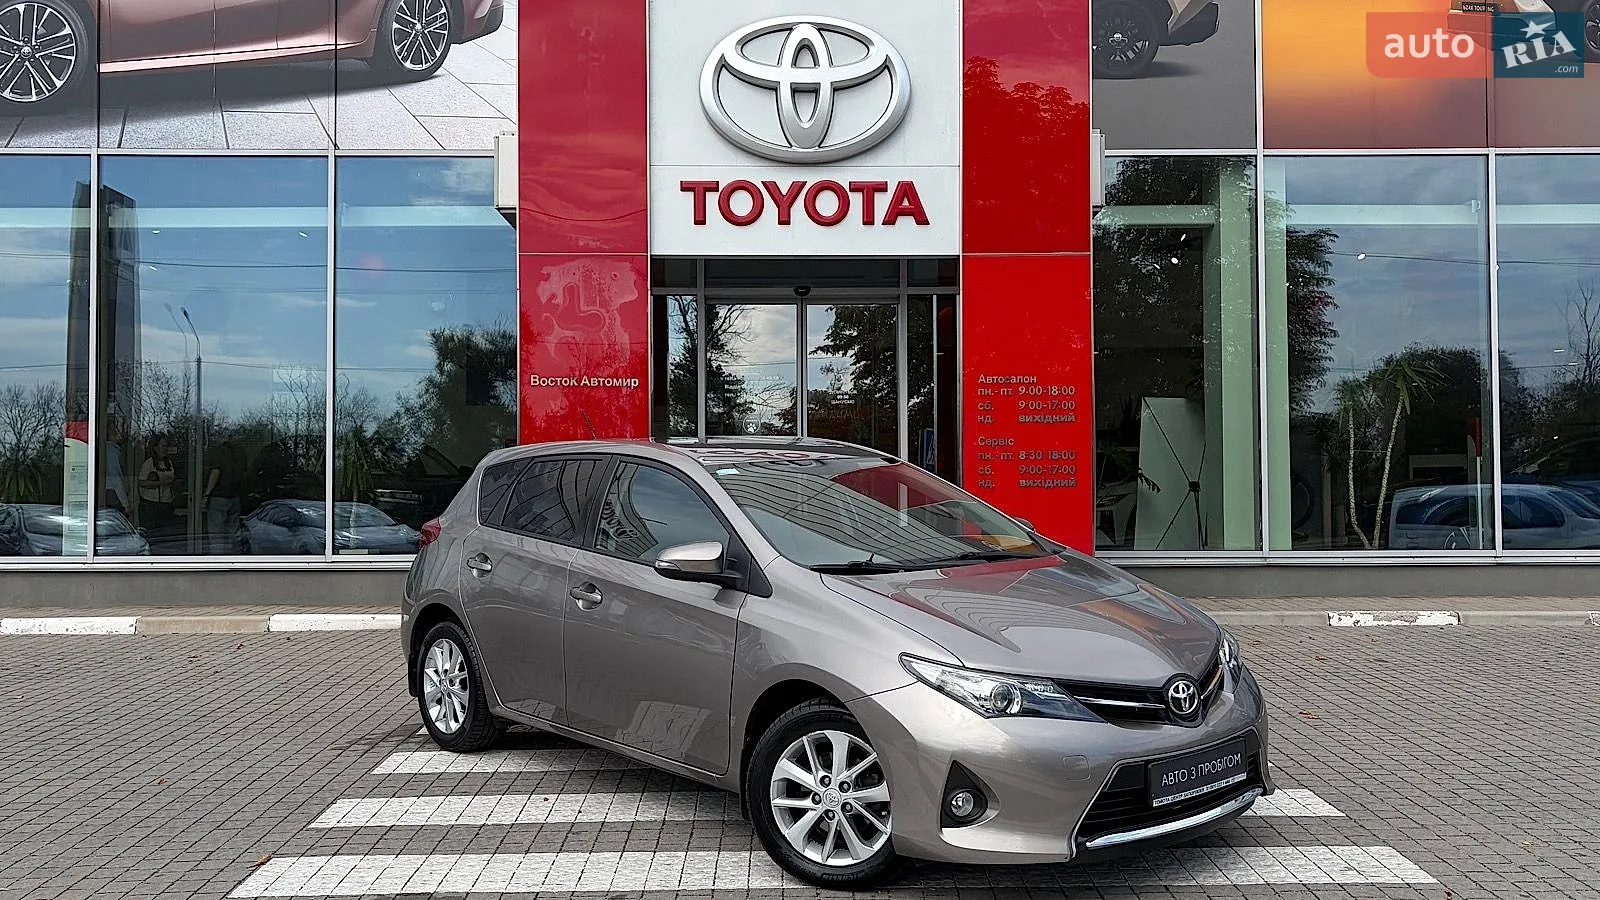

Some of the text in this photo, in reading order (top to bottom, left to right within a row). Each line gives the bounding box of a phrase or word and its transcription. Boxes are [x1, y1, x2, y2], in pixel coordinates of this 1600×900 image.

[680, 179, 931, 226] TOYOTA
[530, 374, 639, 389] Восток Автомир
[978, 374, 1037, 384] Автосалон
[1018, 412, 1076, 424] вихідний
[977, 436, 1015, 447] Сервіс
[1019, 477, 1077, 489] вихідний
[1161, 769, 1188, 787] АВТО
[1198, 753, 1242, 777] ПРОБІГОМ
